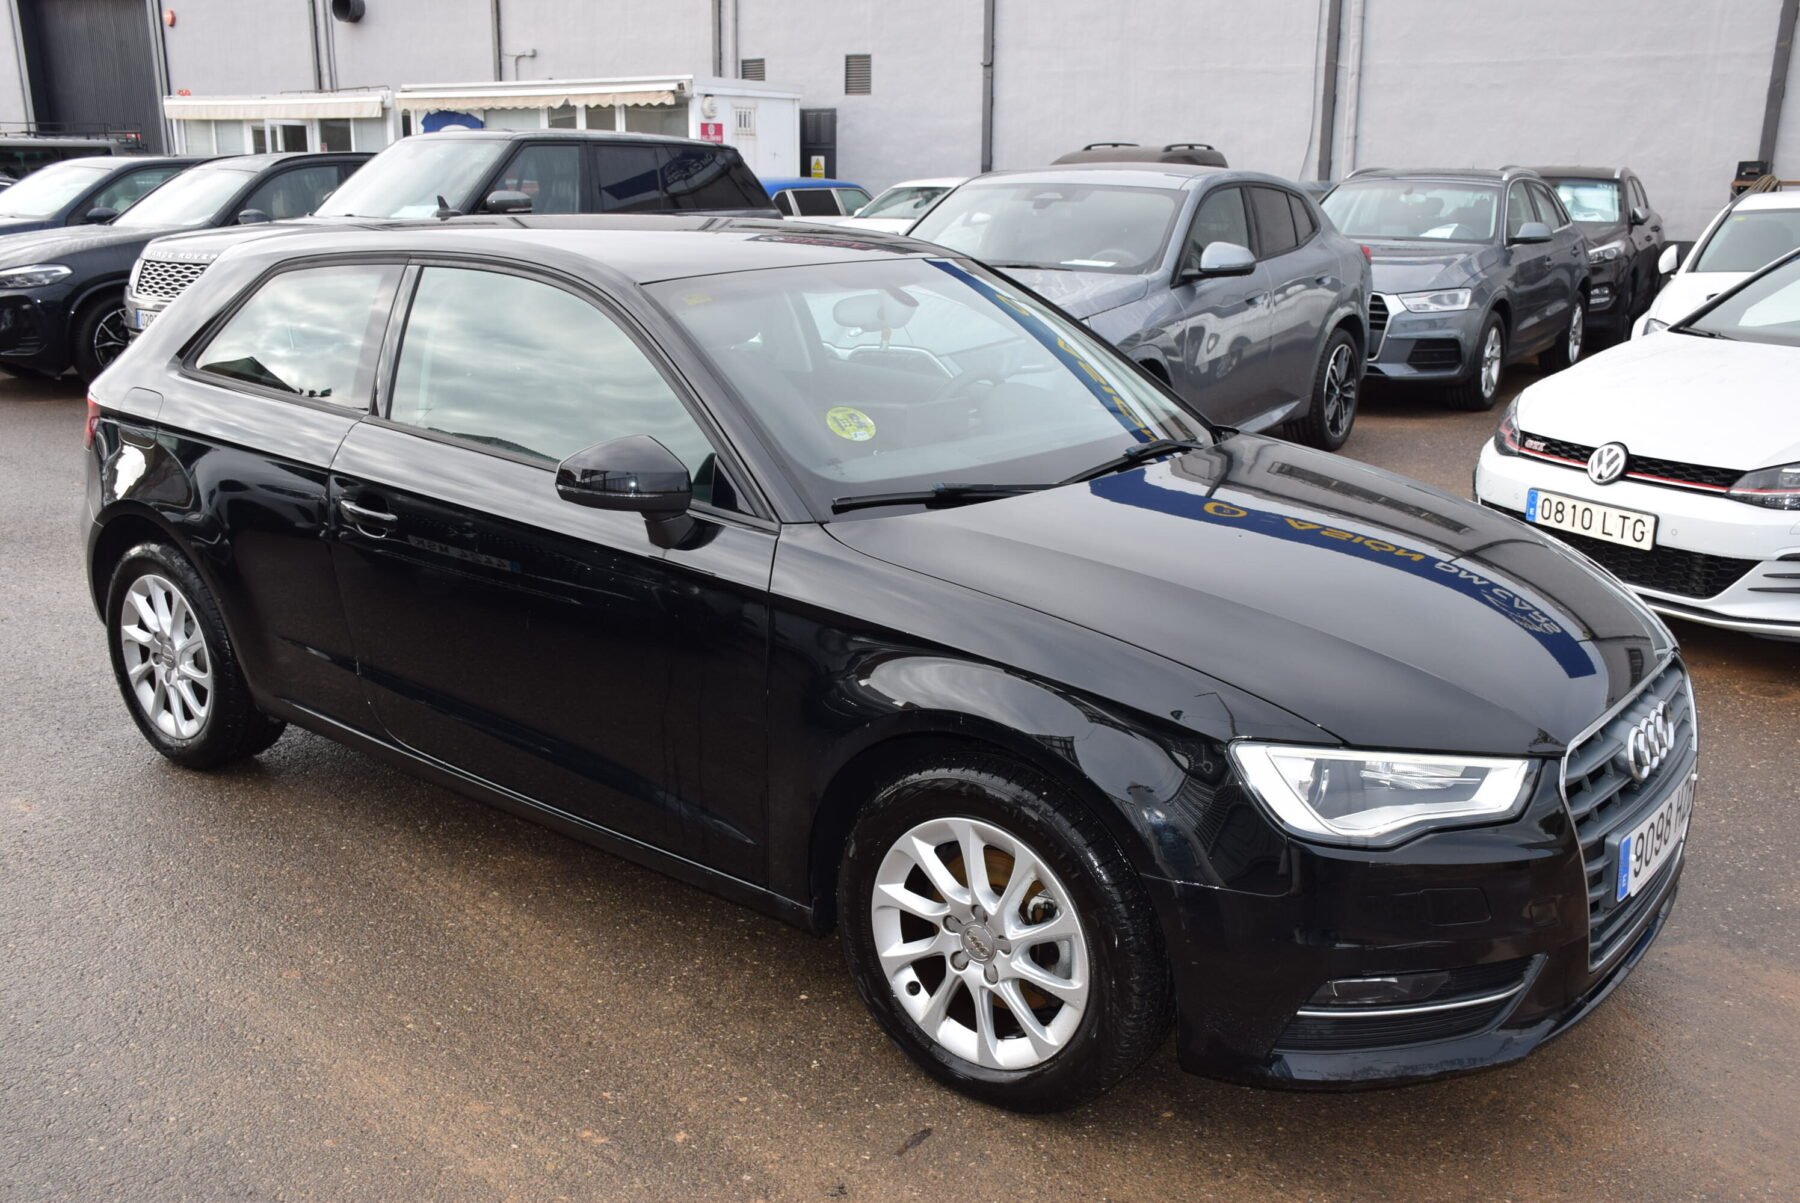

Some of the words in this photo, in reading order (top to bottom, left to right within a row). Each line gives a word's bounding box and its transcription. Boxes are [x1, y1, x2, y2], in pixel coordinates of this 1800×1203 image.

[1541, 498, 1593, 530] 0810
[1602, 511, 1646, 543] LTG
[1633, 802, 1673, 878] 9098
